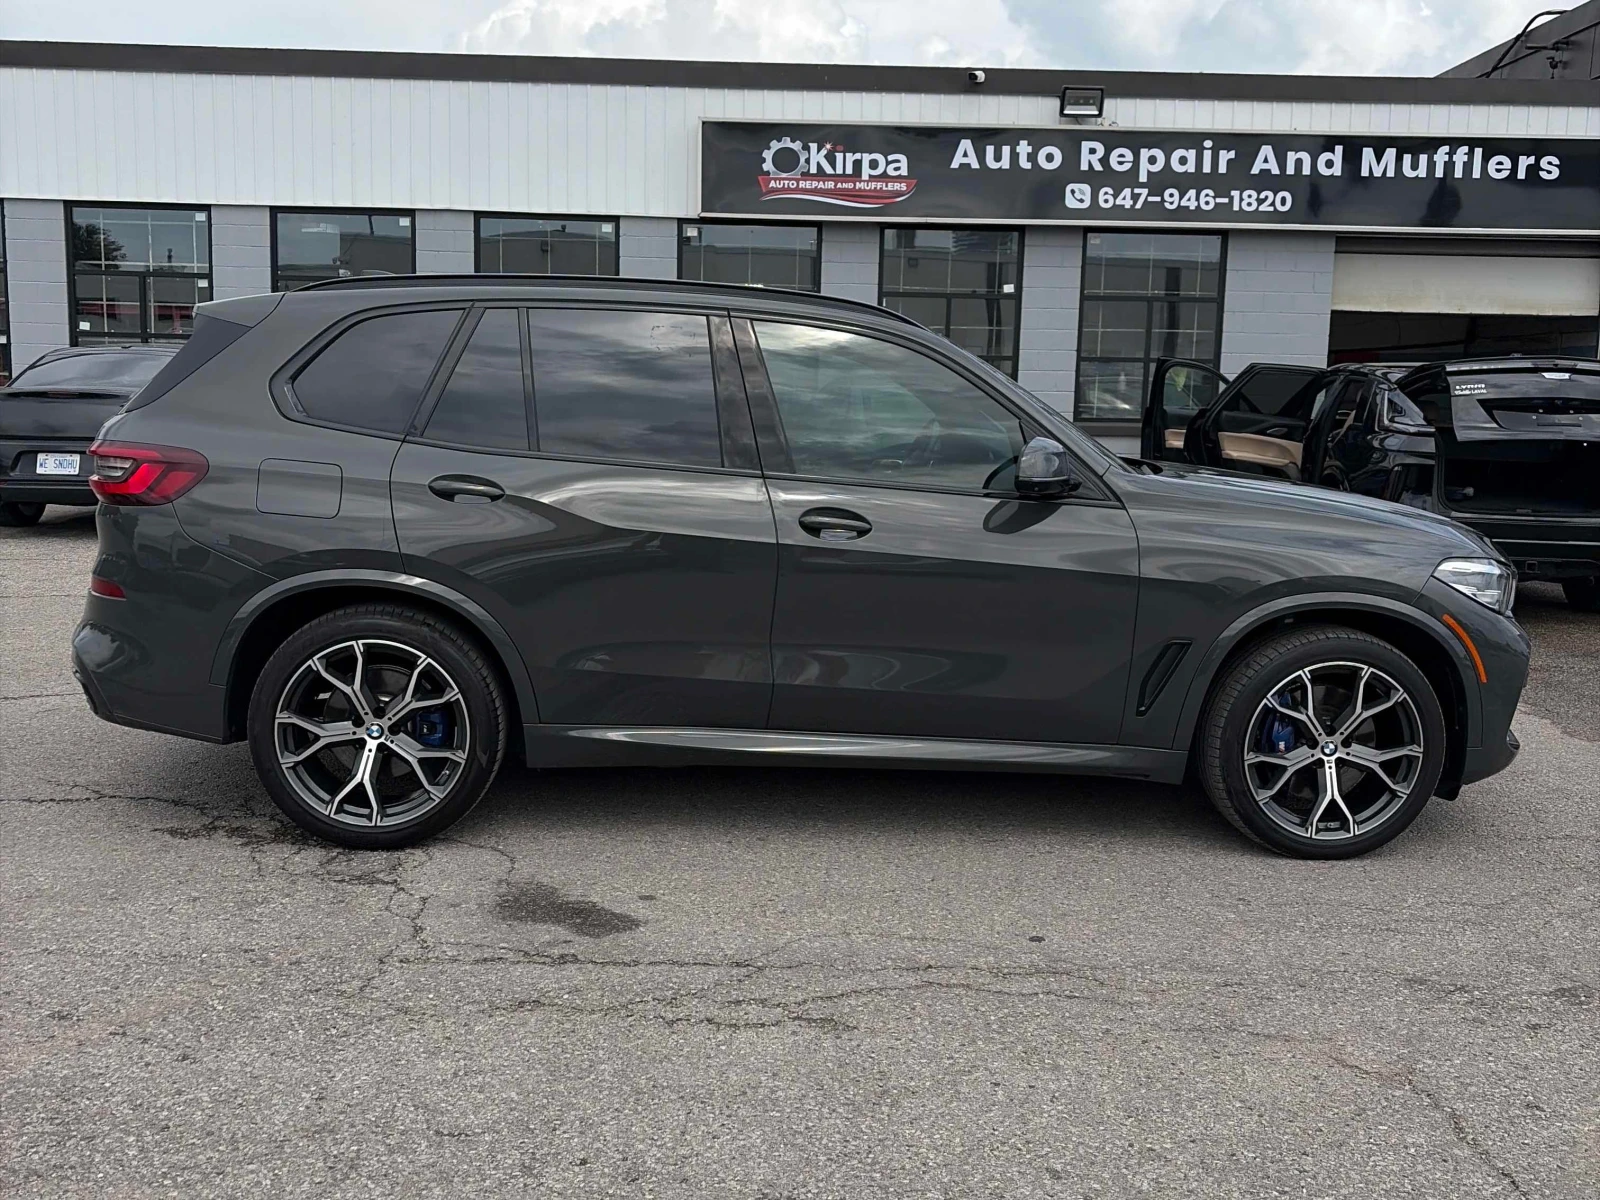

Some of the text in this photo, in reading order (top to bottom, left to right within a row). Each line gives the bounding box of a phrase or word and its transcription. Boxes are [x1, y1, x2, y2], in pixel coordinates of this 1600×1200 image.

[808, 142, 909, 180] Kirpa
[950, 139, 1561, 182] Auto Repair And Mufflers
[769, 180, 797, 189] AUTO
[799, 180, 834, 190] REPAIR
[855, 181, 907, 191] MUFFLERS
[1098, 187, 1292, 211] 647-946-1820
